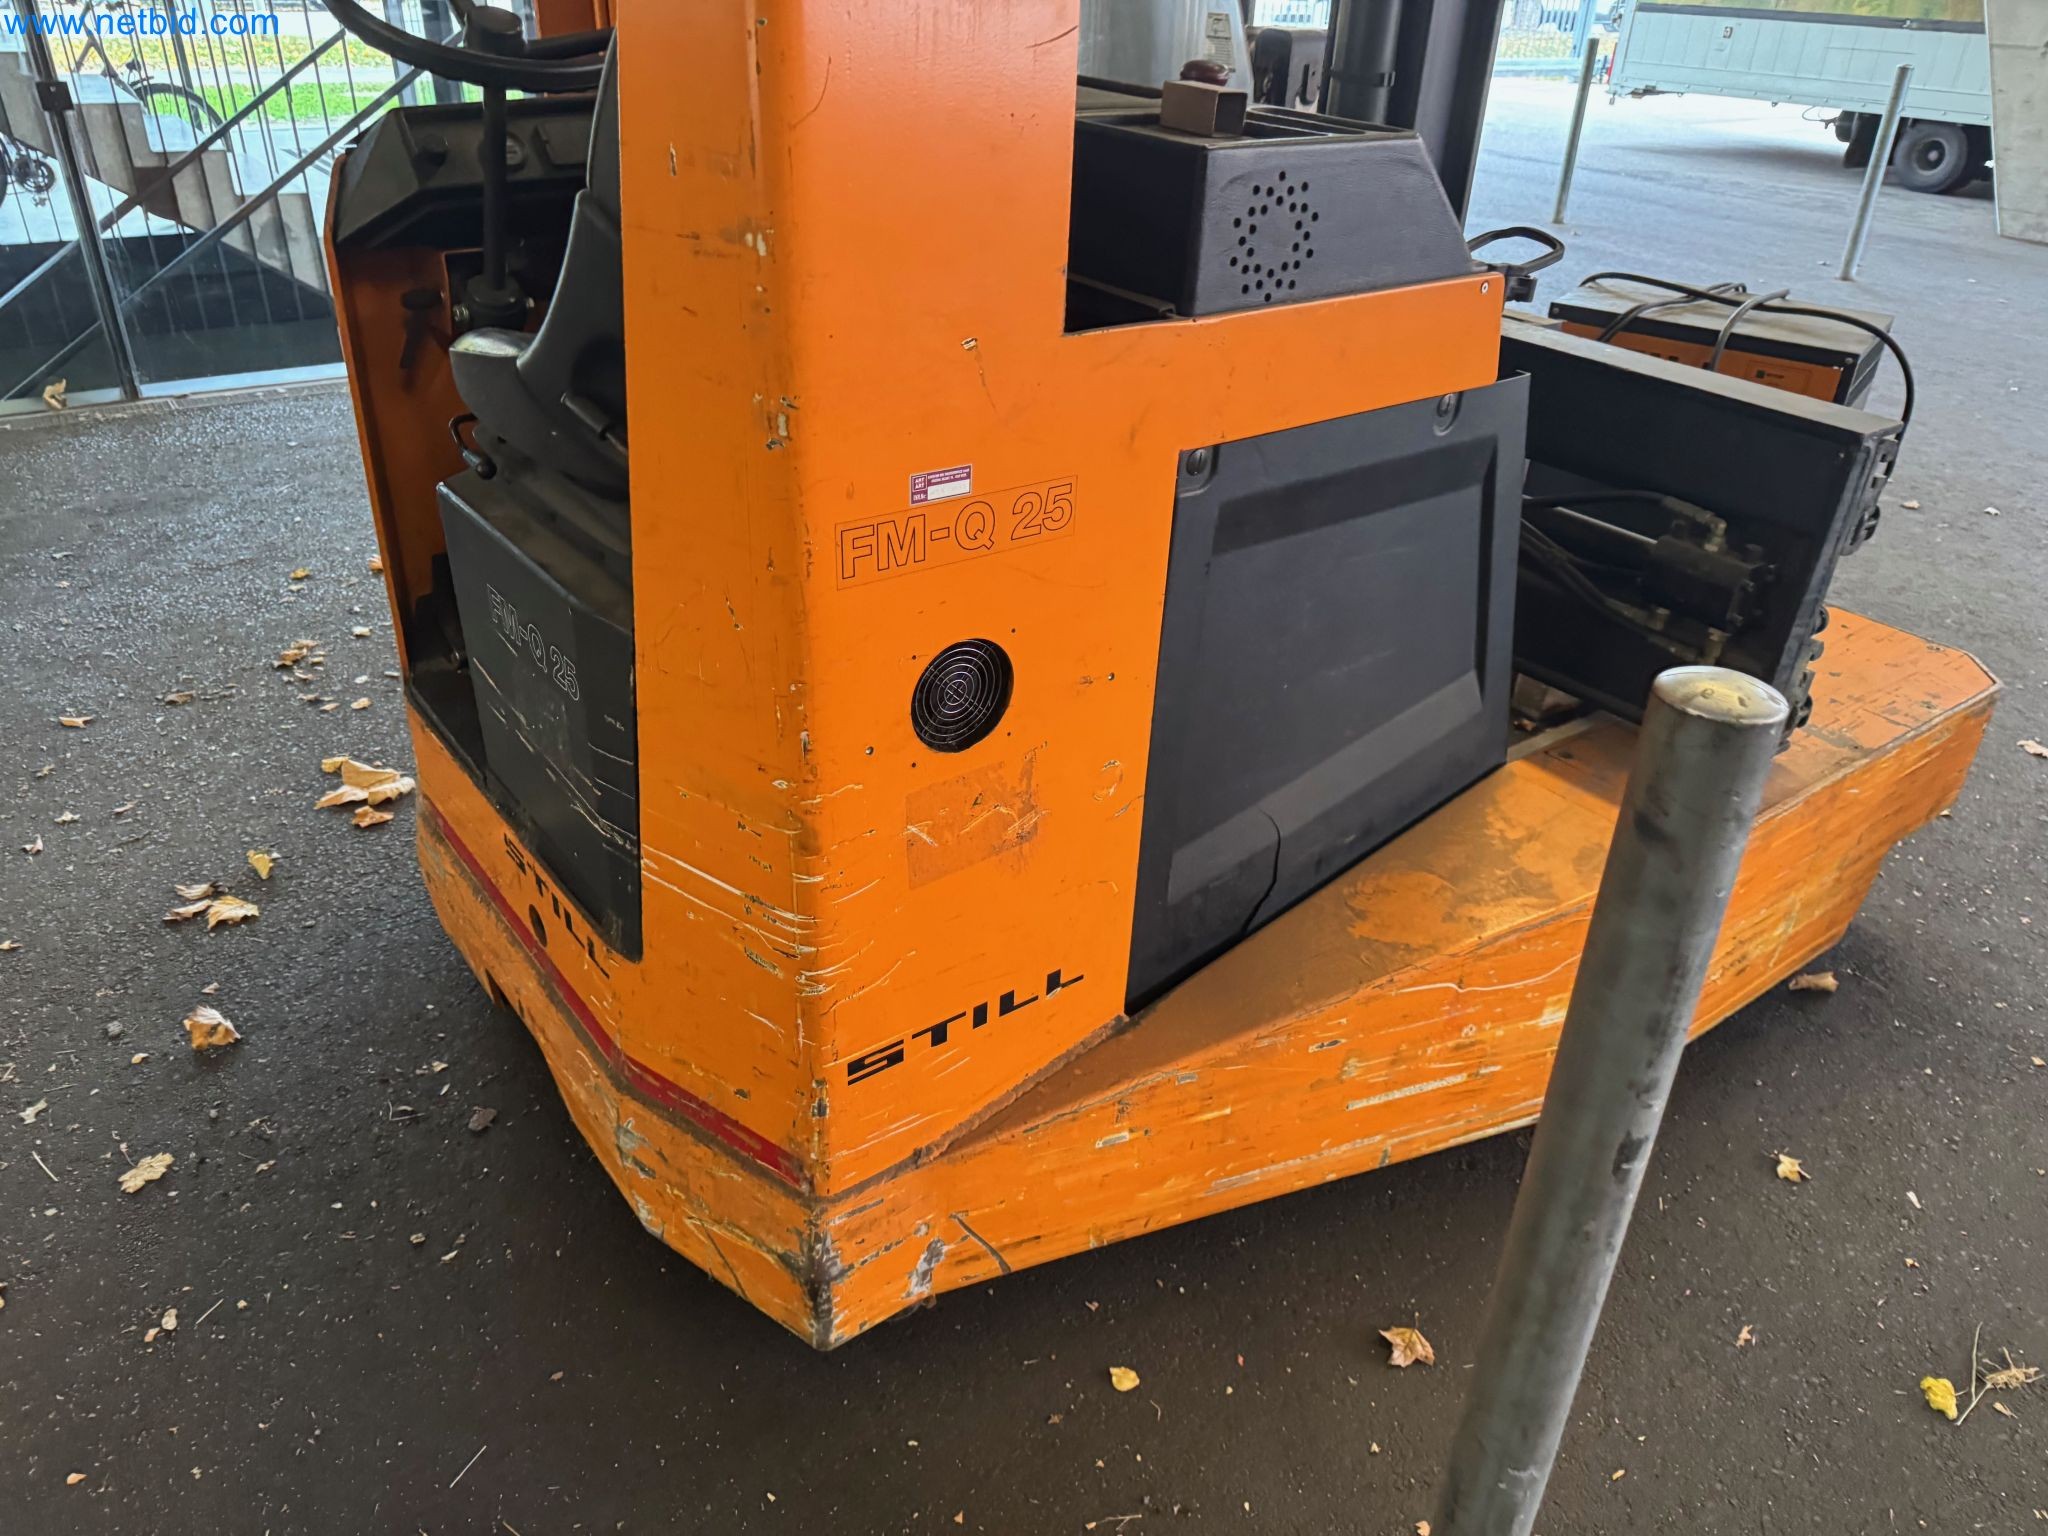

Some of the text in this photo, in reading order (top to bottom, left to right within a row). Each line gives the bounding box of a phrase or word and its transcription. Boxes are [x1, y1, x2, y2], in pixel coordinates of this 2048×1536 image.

[840, 482, 1073, 580] FM-Q 25
[549, 645, 580, 701] 25
[503, 832, 611, 980] STILL
[847, 968, 1084, 1087] STILL
